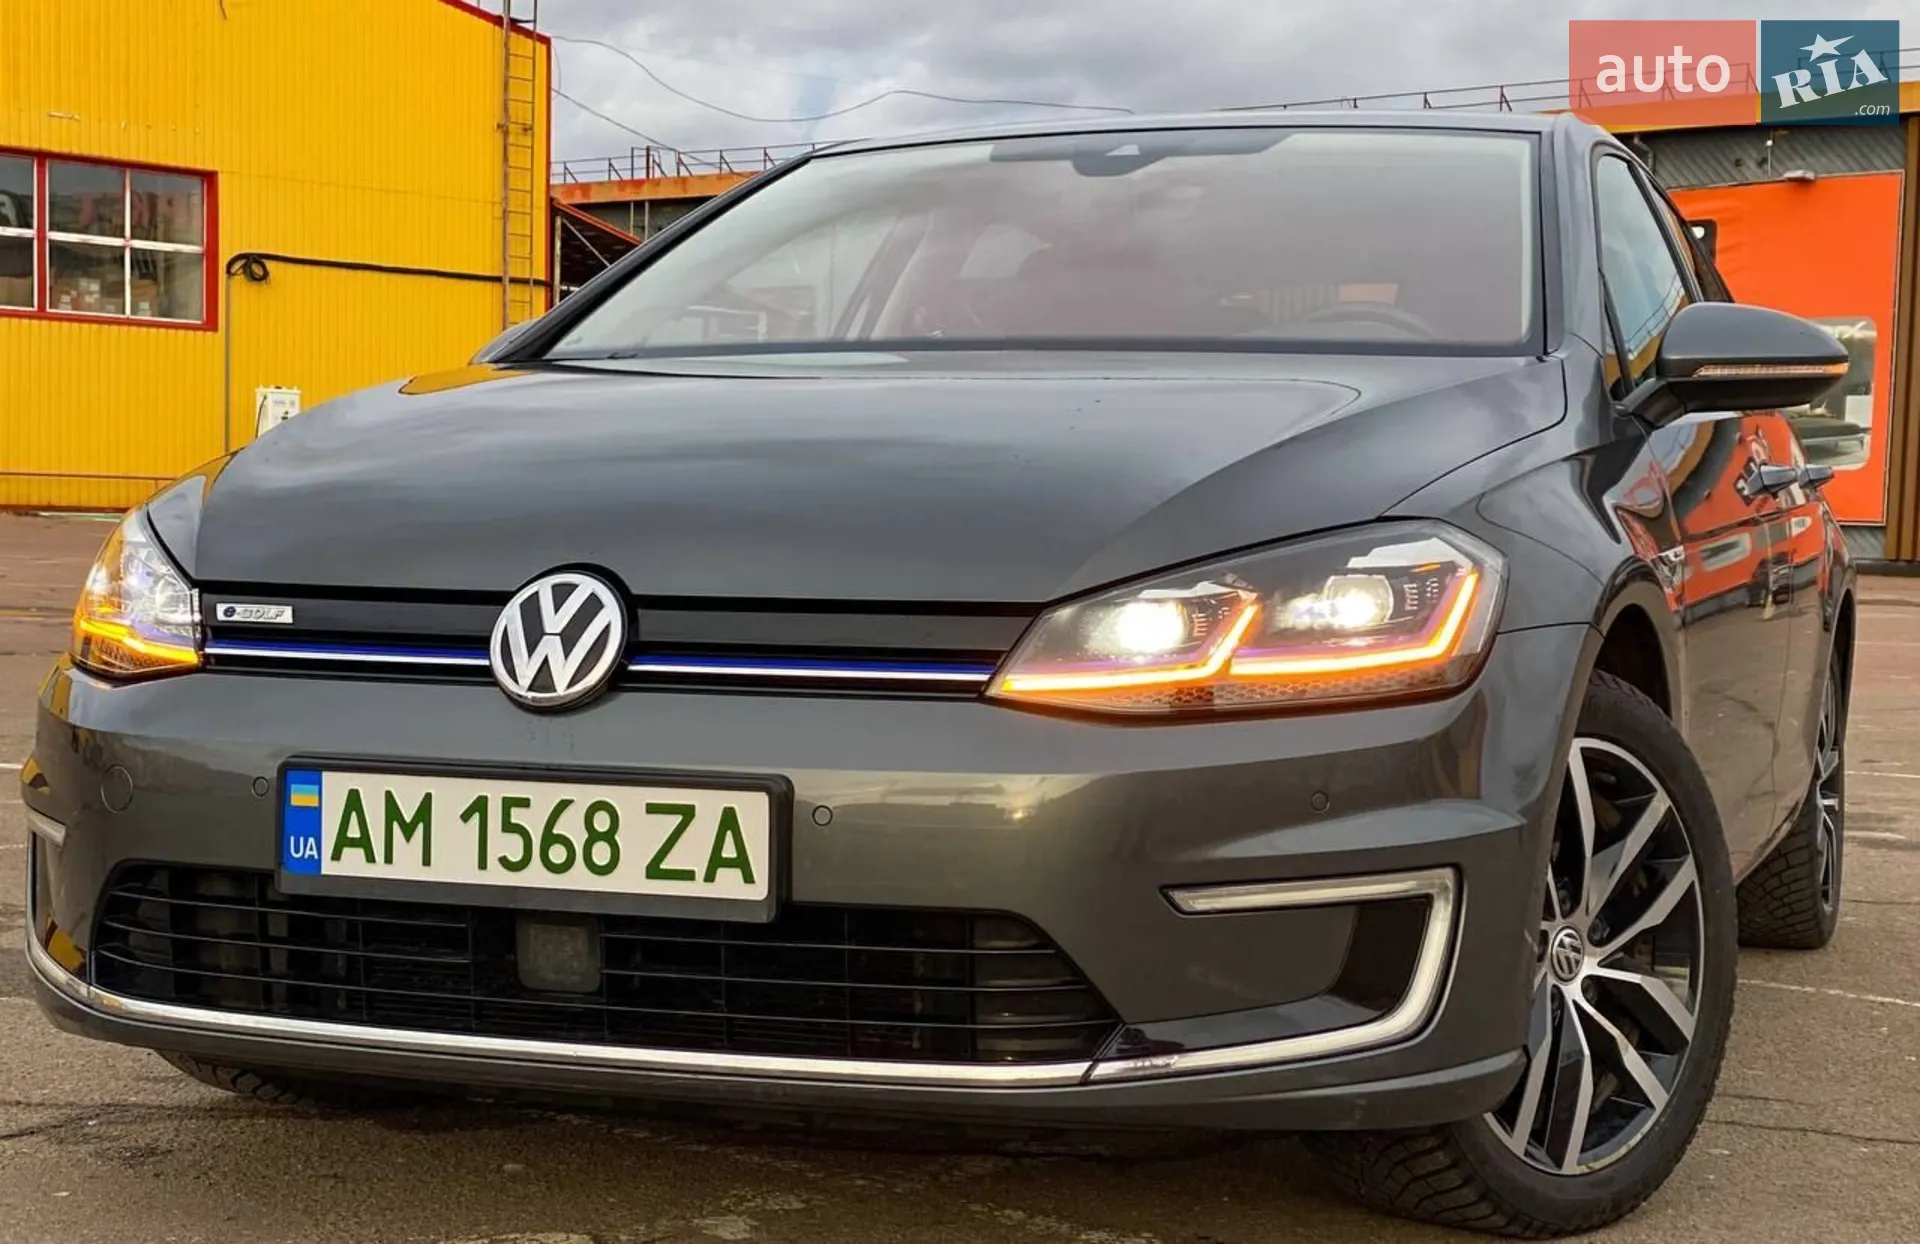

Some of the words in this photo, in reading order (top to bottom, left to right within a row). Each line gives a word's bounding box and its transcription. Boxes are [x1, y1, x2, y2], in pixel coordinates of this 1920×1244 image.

[491, 573, 622, 704] VW
[289, 835, 319, 860] UA
[331, 788, 435, 866] AM
[459, 794, 621, 876] 1568
[645, 802, 756, 884] ZA
